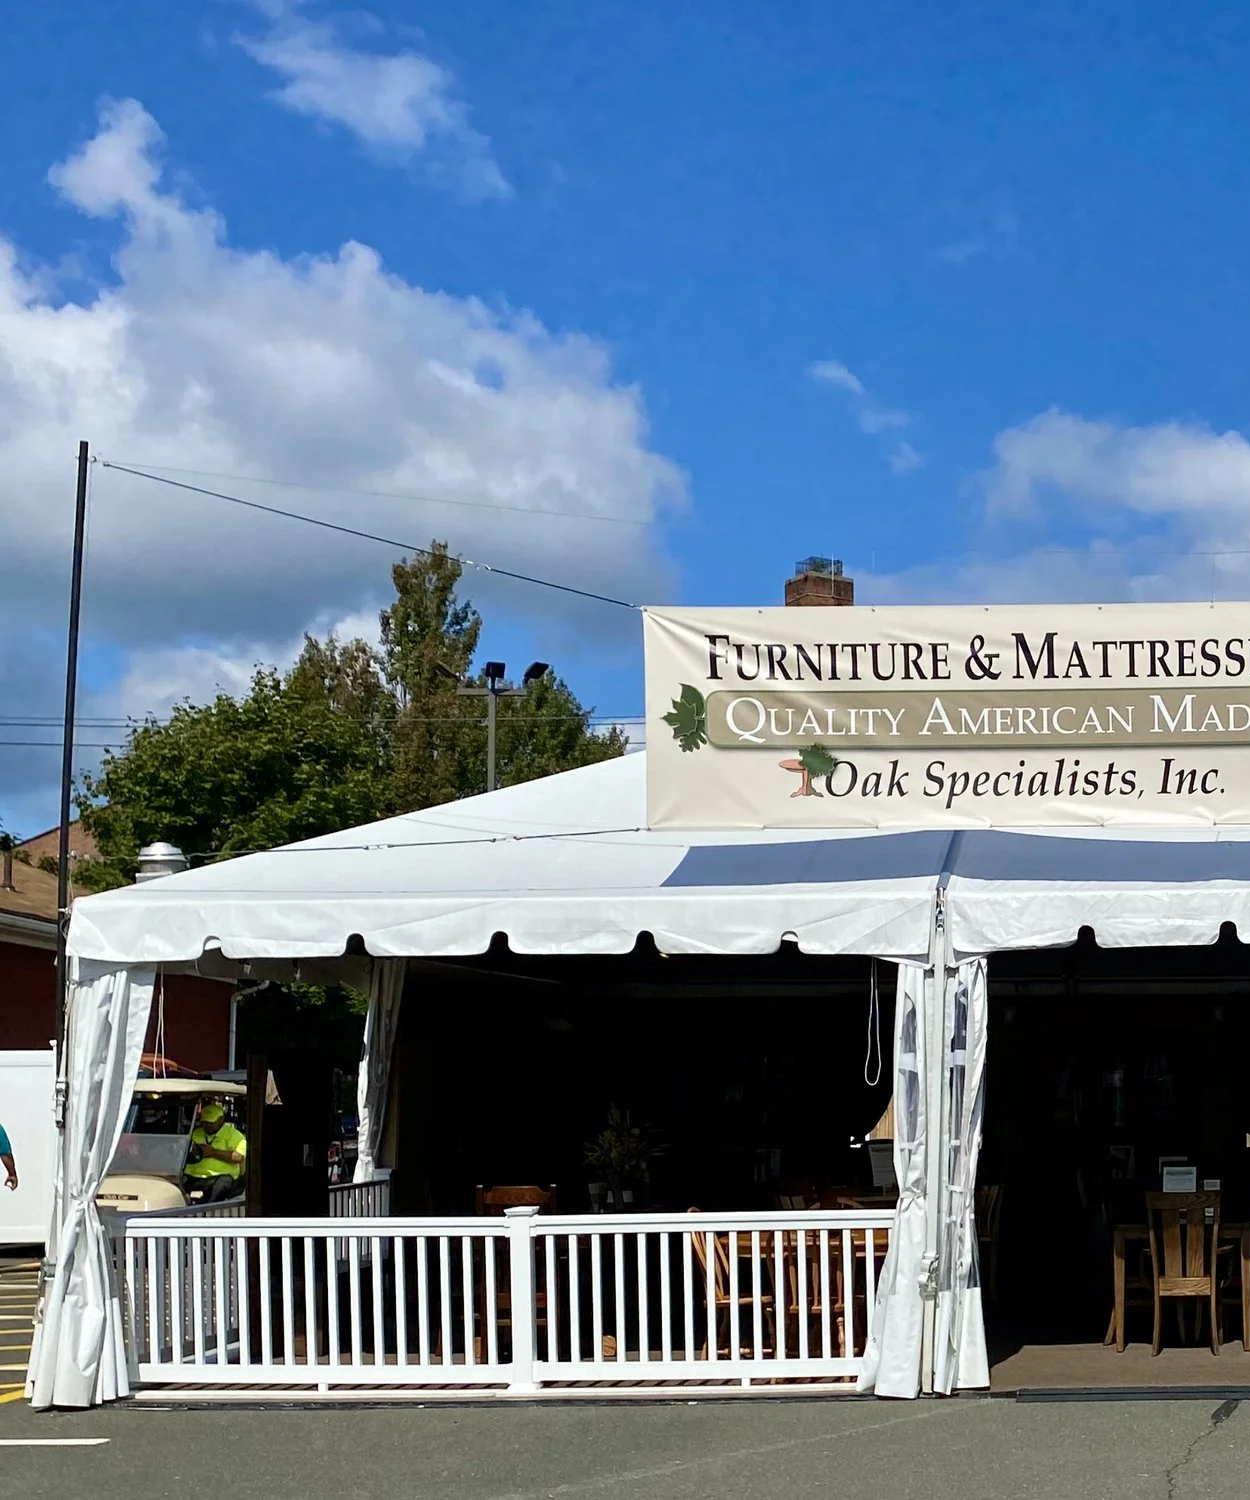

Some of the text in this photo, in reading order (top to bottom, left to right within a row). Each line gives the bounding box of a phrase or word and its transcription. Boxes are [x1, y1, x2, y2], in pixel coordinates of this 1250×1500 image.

[704, 634, 951, 681] FURNITURE
[964, 634, 1003, 681] &
[725, 697, 906, 744] QUALITY
[918, 697, 1135, 736] AMERICAN
[825, 757, 1226, 810] Oak Specialists, Inc.
